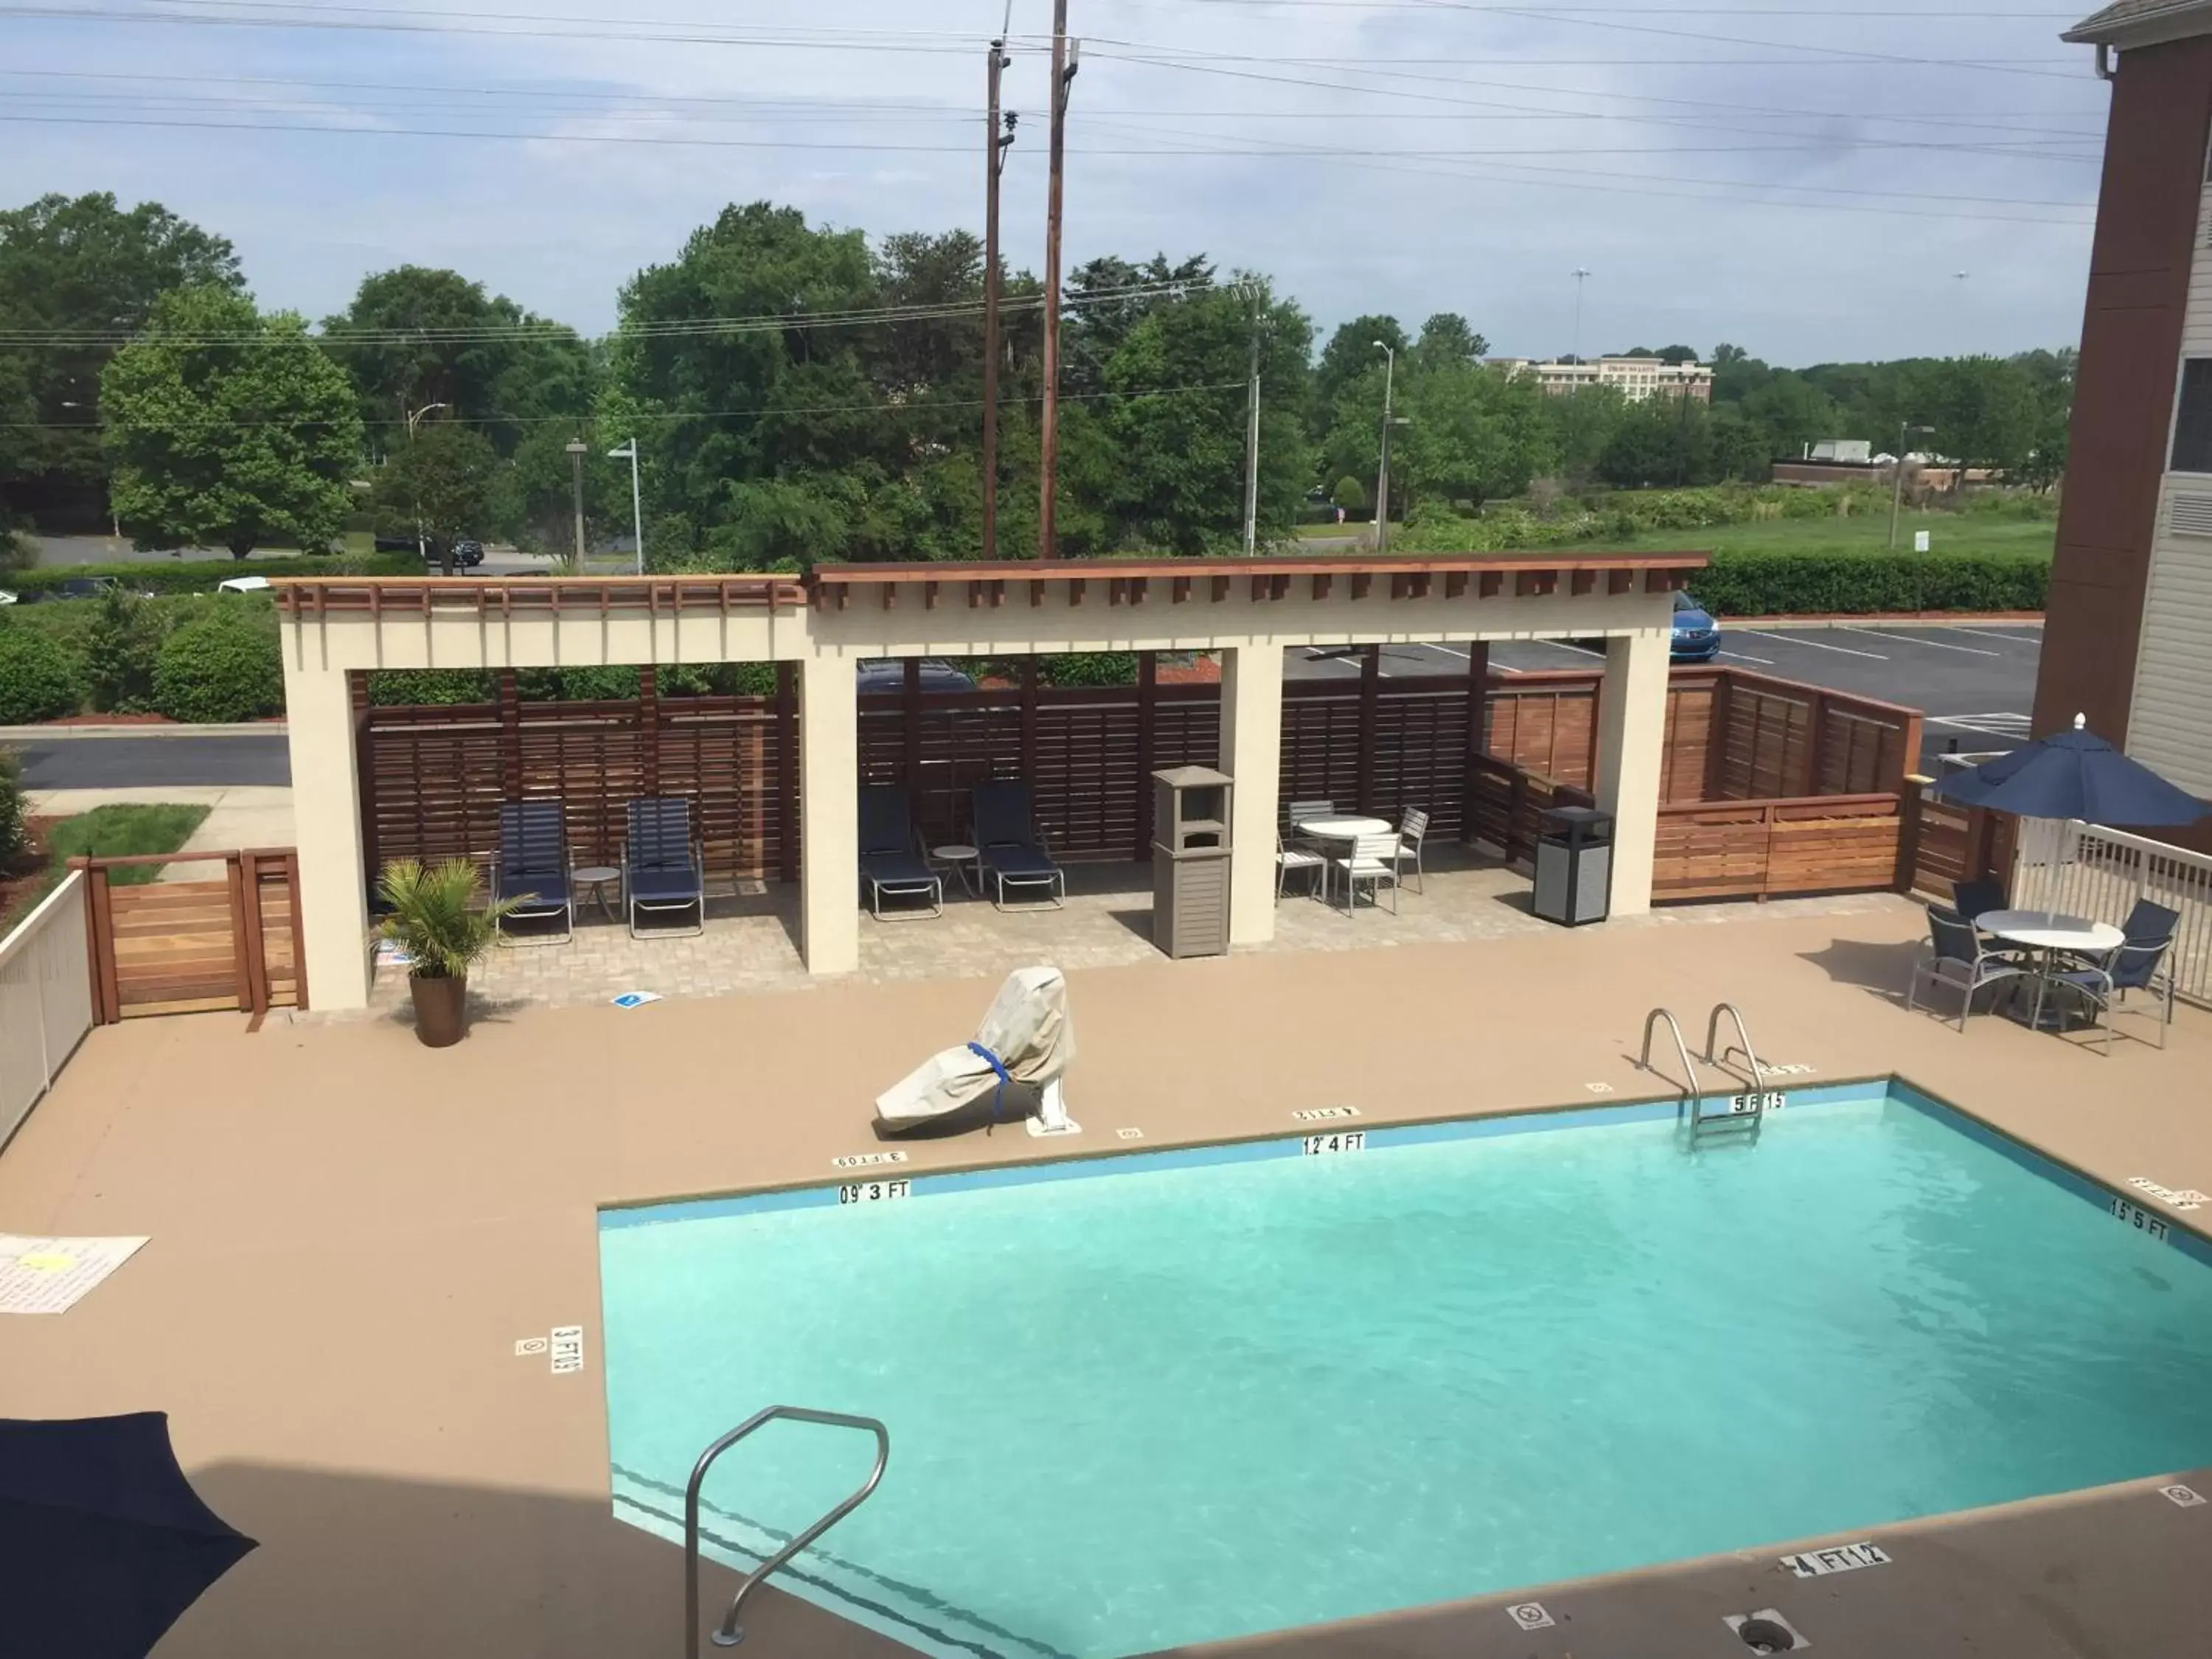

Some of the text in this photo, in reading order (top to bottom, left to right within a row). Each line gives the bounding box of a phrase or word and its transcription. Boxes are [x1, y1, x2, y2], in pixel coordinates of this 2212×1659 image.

[1329, 1136, 1339, 1152] 4
[1346, 1133, 1363, 1150] FT
[869, 1184, 880, 1200] 3
[888, 1180, 908, 1197] FT
[2133, 1211, 2144, 1229] 5
[2149, 1219, 2167, 1239] FT
